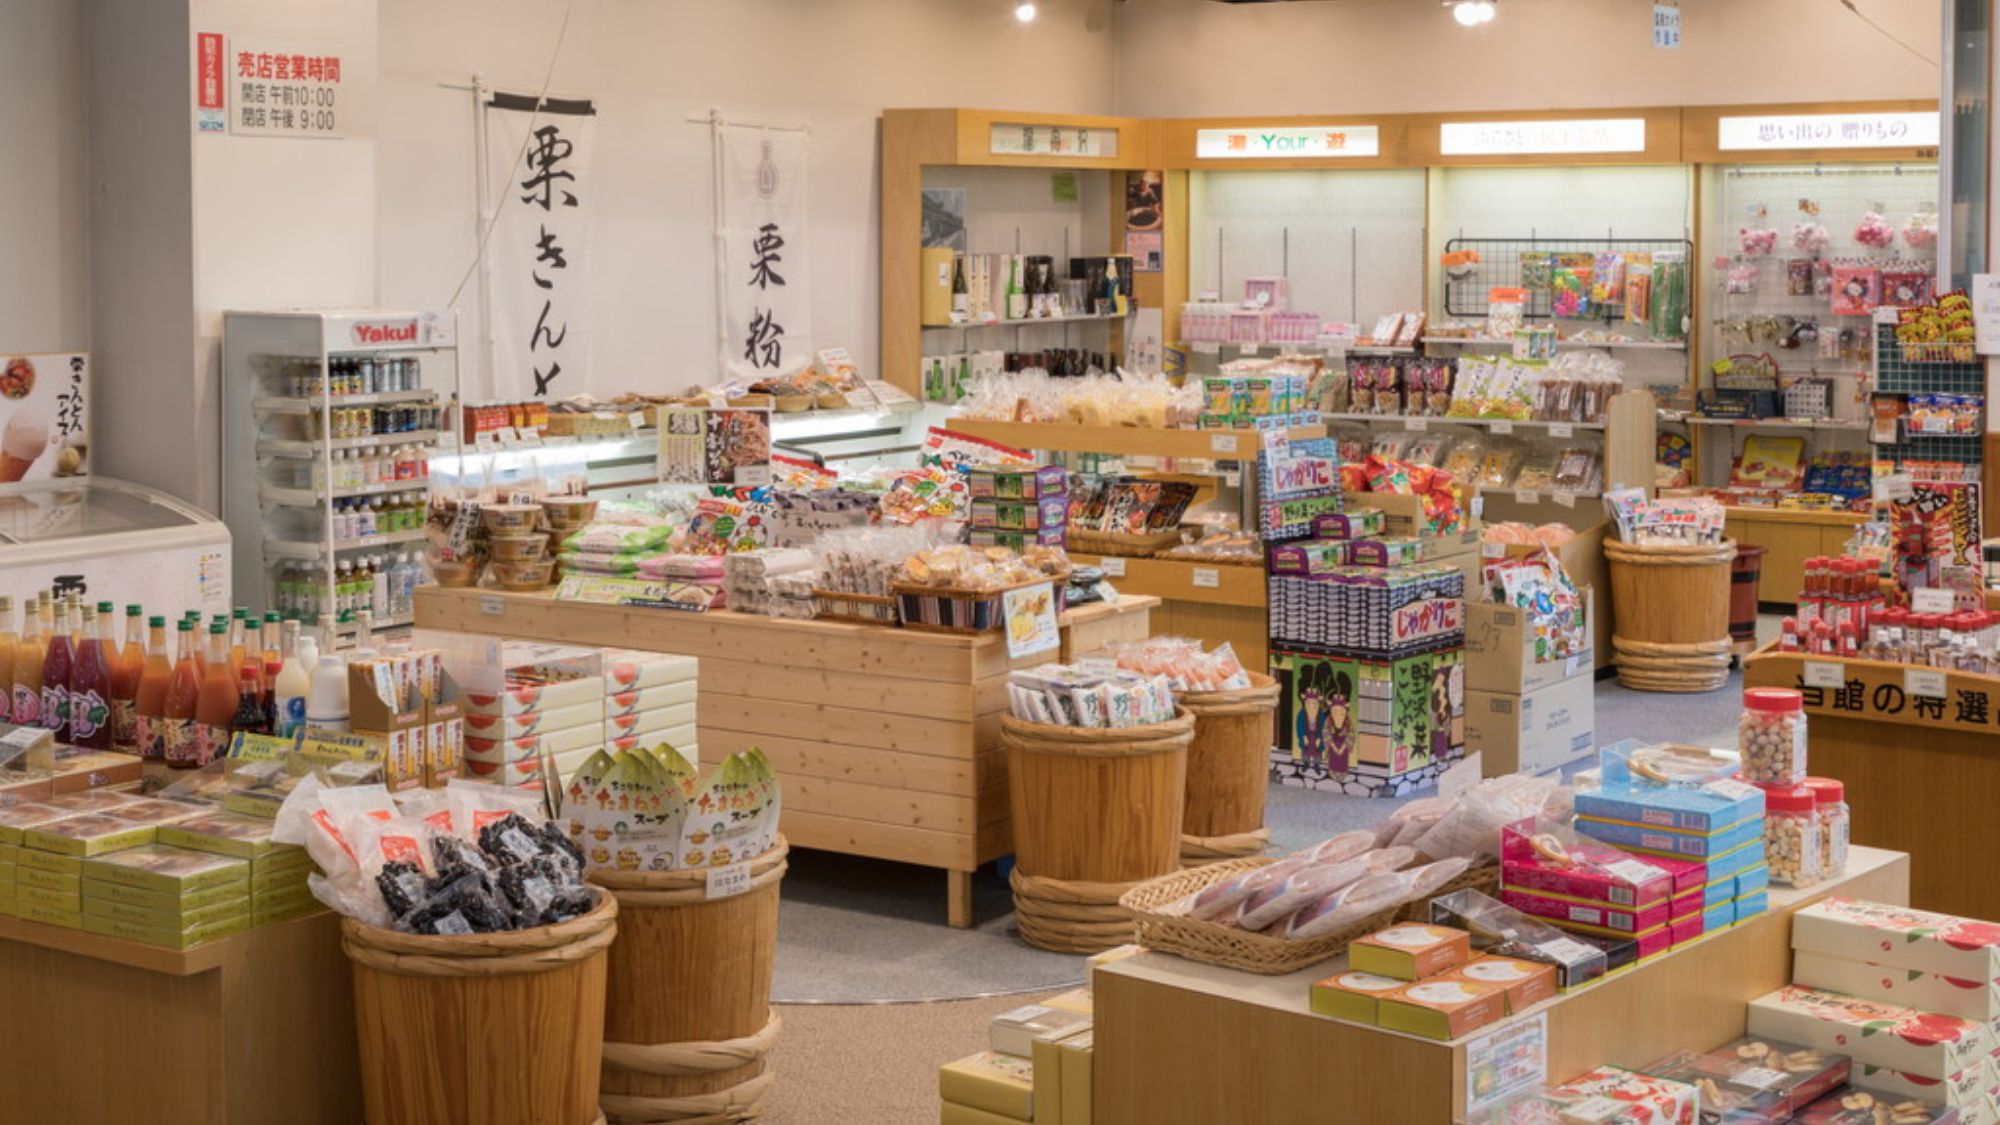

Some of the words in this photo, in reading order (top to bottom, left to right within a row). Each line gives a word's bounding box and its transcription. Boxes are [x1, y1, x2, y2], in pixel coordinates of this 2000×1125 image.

[238, 51, 341, 82] 売店営業時間
[270, 108, 294, 129] 午後
[300, 109, 335, 130] 9:00
[1260, 133, 1309, 151] Your
[745, 223, 786, 369] 栗粉
[355, 323, 417, 342] Yakul
[1397, 601, 1457, 638] じゃがりこ
[1796, 675, 2000, 727] 当館の特選
[634, 813, 669, 825] スープ
